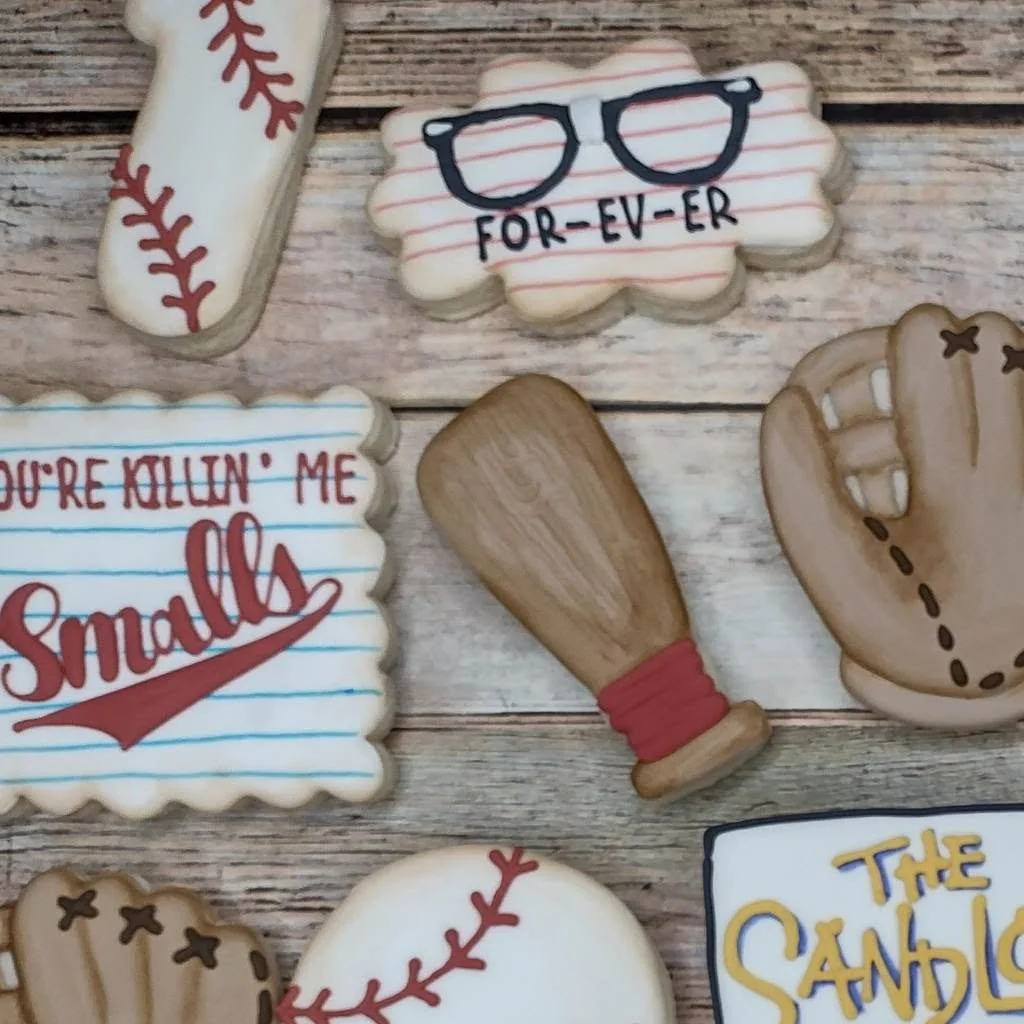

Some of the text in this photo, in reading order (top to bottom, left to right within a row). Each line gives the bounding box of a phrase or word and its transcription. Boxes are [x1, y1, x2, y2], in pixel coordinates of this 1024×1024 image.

[475, 186, 738, 262] FOR-EV-ER
[123, 453, 271, 509] KILLIN'
[297, 452, 356, 504] ME
[0, 512, 311, 702] Smalls
[833, 829, 990, 905] THE
